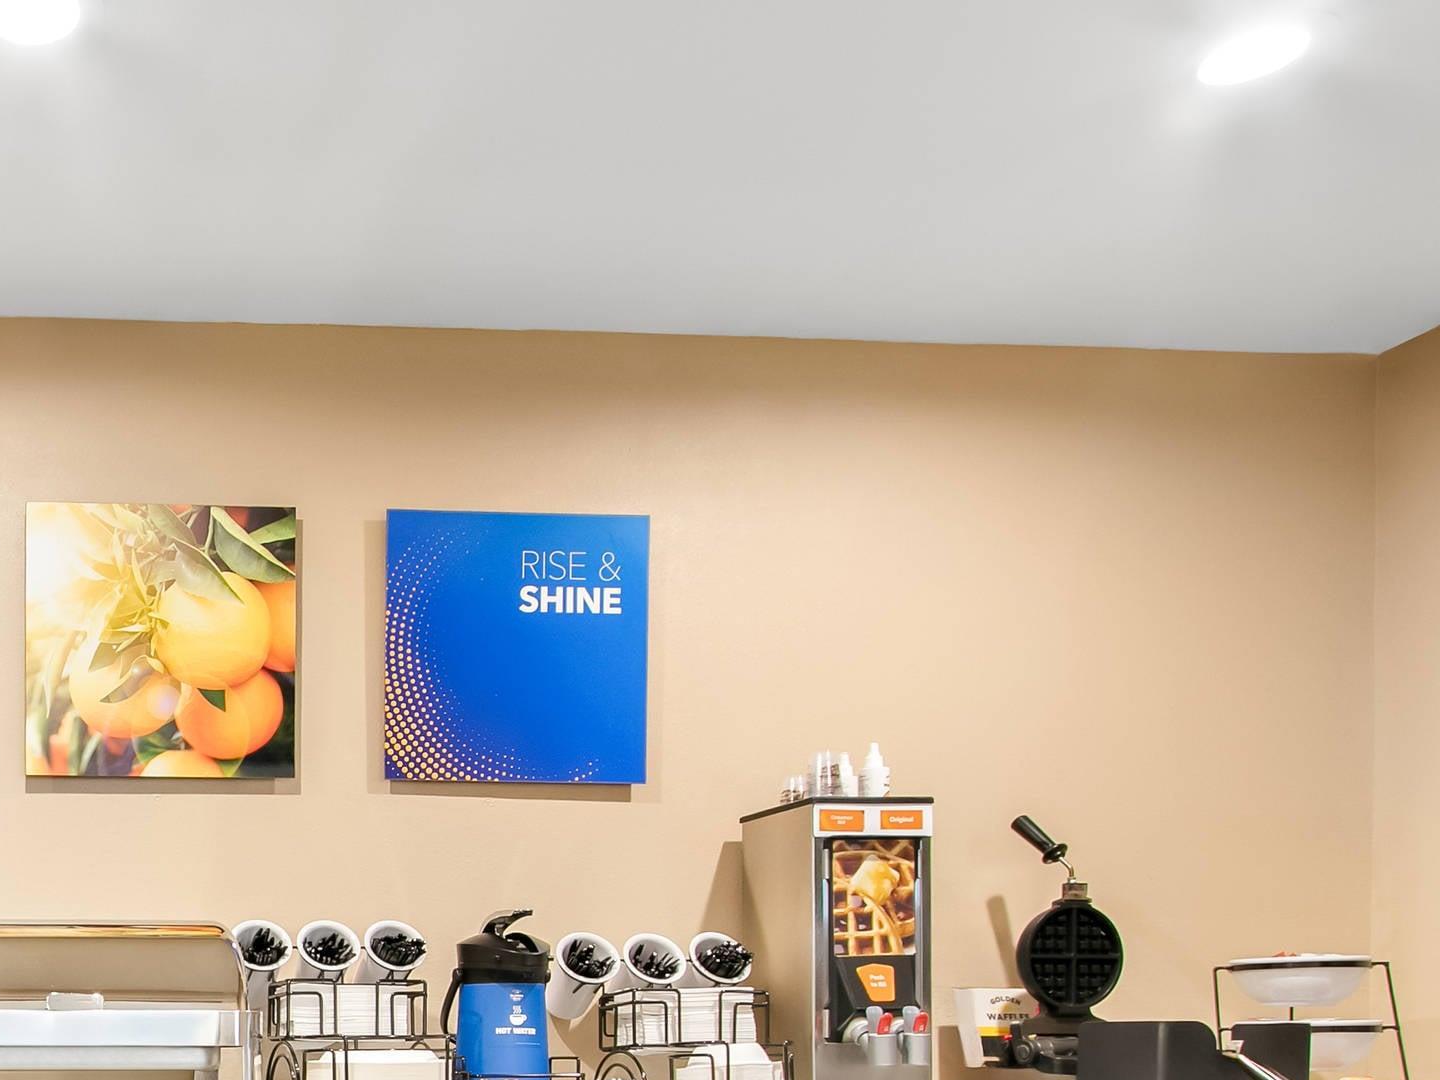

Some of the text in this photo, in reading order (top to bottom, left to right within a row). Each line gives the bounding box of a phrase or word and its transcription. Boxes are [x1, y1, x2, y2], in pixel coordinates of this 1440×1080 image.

[521, 550, 621, 582] RISE &
[519, 585, 622, 615] SHINE
[990, 996, 1021, 1005] GOLDEN
[495, 1027, 536, 1035] HOT WATER
